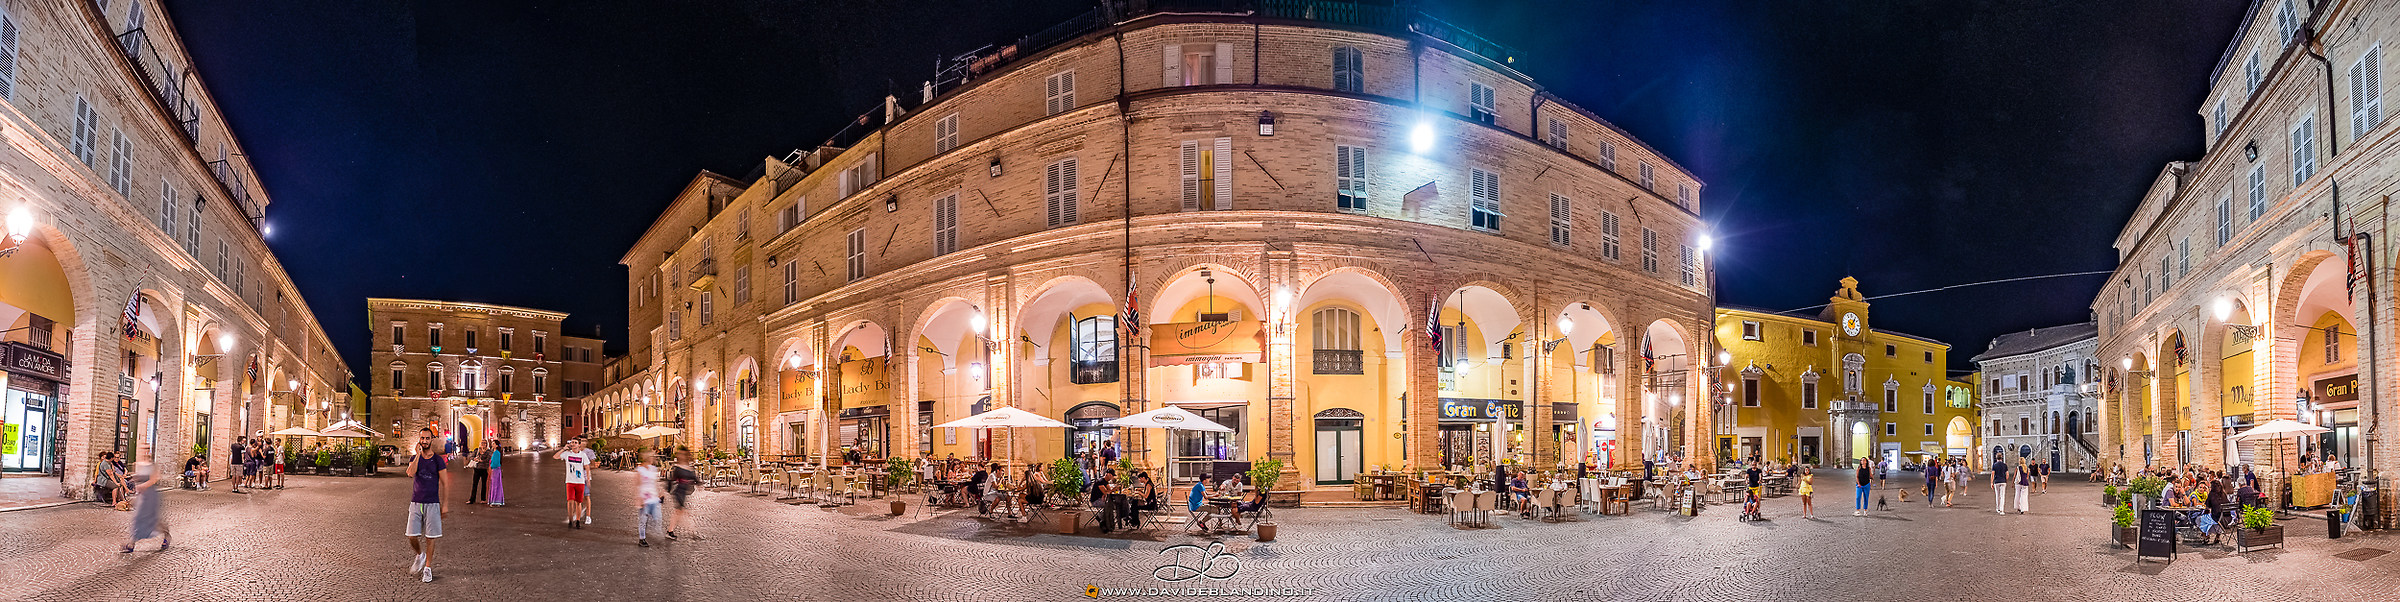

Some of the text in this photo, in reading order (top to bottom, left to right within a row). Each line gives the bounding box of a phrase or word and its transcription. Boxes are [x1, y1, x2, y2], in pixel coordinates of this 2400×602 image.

[24, 353, 32, 361] LA
[19, 359, 33, 369] CON
[34, 363, 55, 374] AMORE
[782, 389, 802, 400] Lady
[843, 382, 869, 395] Lady
[2326, 383, 2347, 397] Gran
[1444, 401, 1519, 418] Gran Caffè
